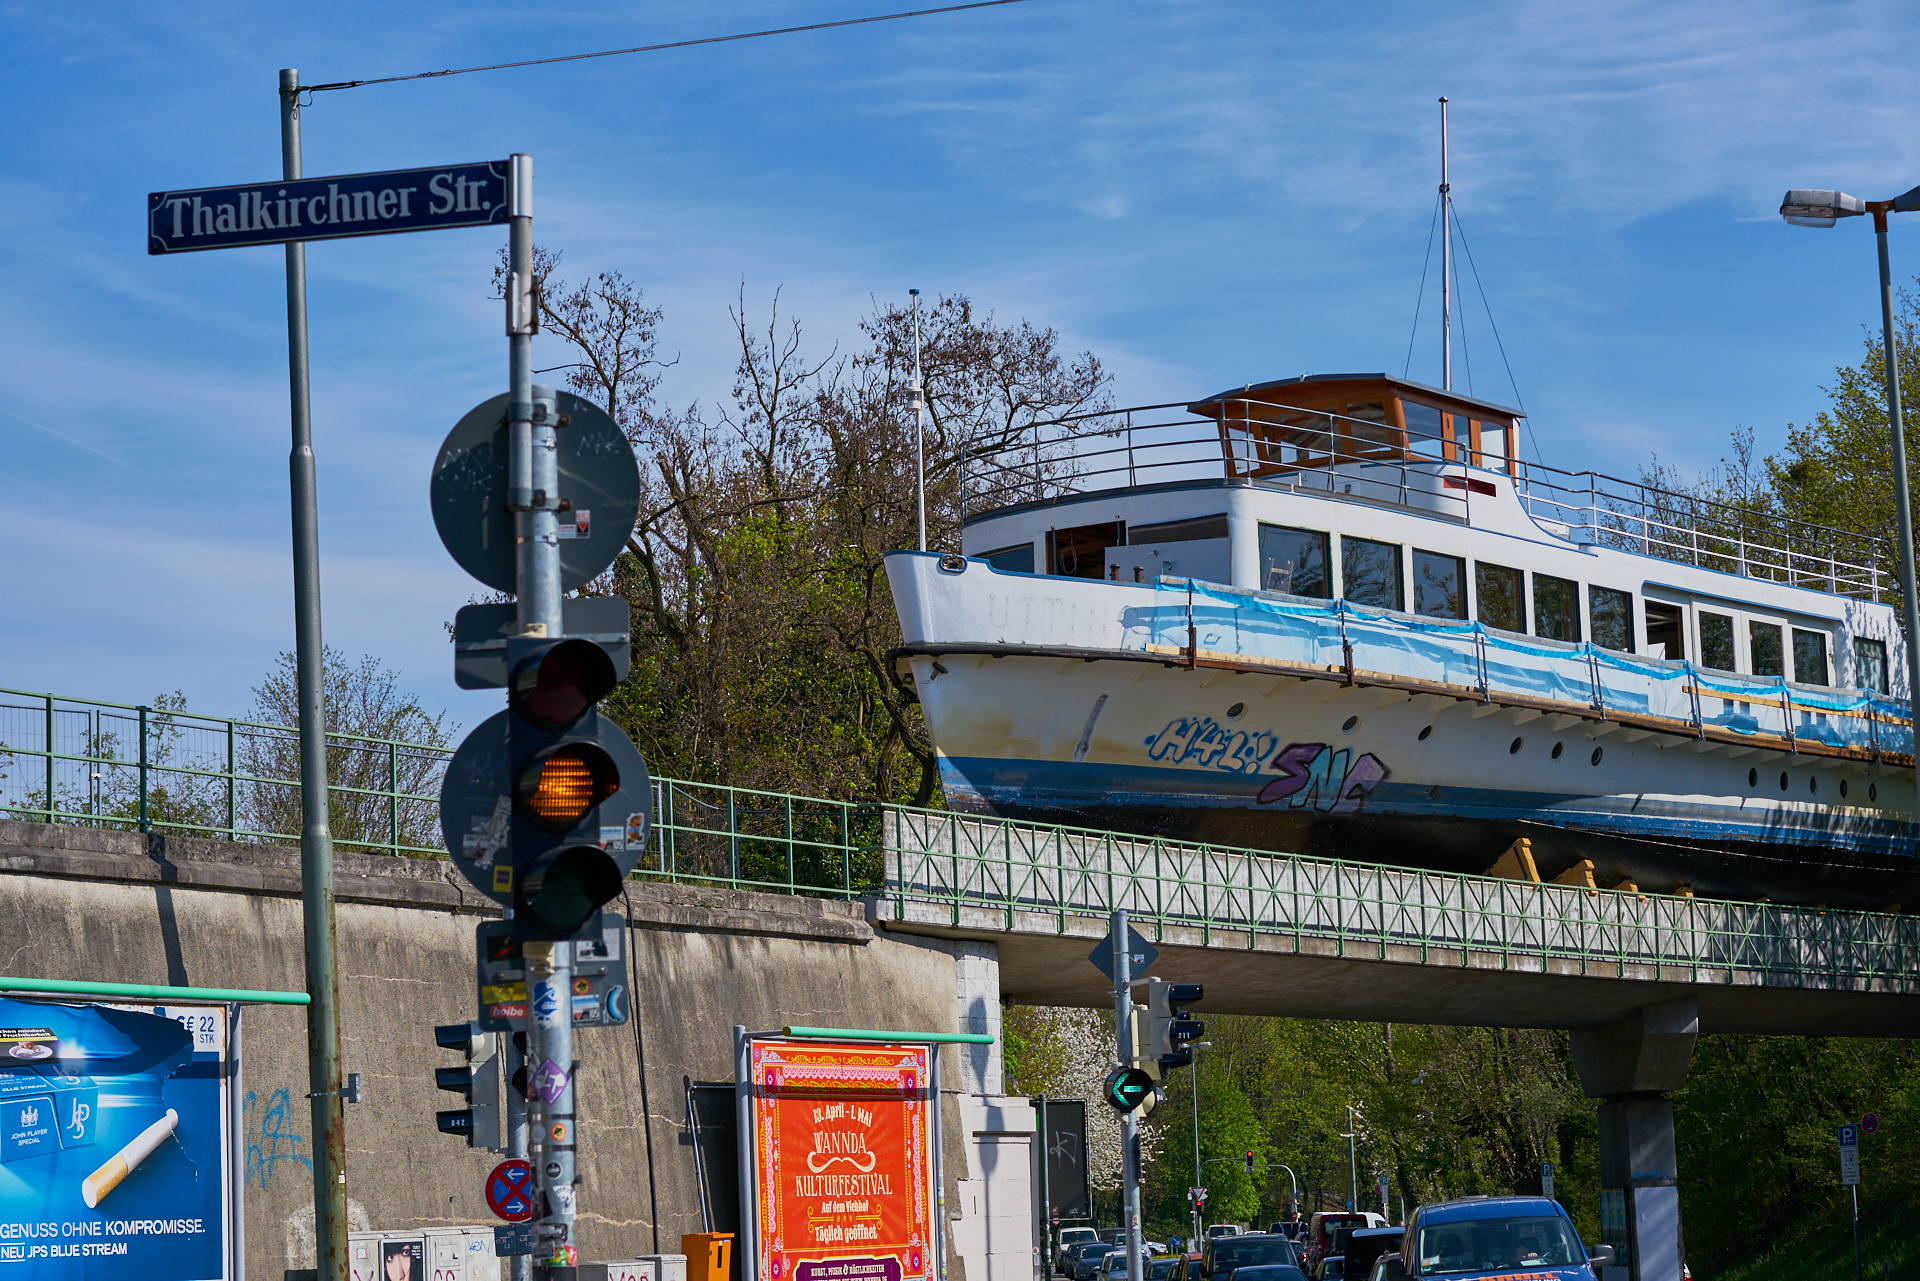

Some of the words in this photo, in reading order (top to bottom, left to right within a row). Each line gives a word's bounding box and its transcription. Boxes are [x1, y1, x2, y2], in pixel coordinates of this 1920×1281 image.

[165, 184, 417, 238] Thalkirchner
[429, 173, 492, 215] Str.
[200, 1016, 214, 1032] 22
[200, 1034, 214, 1044] STK
[825, 1102, 844, 1122] April
[27, 1128, 48, 1137] PLAYER
[18, 1138, 40, 1146] SPECIAL
[813, 1130, 866, 1154] WANNDA
[796, 1172, 892, 1198] KULTURFESTIVAL
[822, 1201, 832, 1213] Auf
[832, 1201, 845, 1212] dem
[846, 1200, 869, 1212] Viehhof
[0, 1222, 58, 1239] GENUSS
[61, 1221, 102, 1238] OHNE
[105, 1219, 206, 1236] KOMPROMISSE.
[815, 1225, 843, 1244] Täglich
[844, 1224, 878, 1244] geöffnet
[0, 1246, 25, 1259] NEU
[27, 1245, 48, 1258] JPS
[50, 1244, 80, 1258] BLUE
[82, 1242, 128, 1256] STREAM
